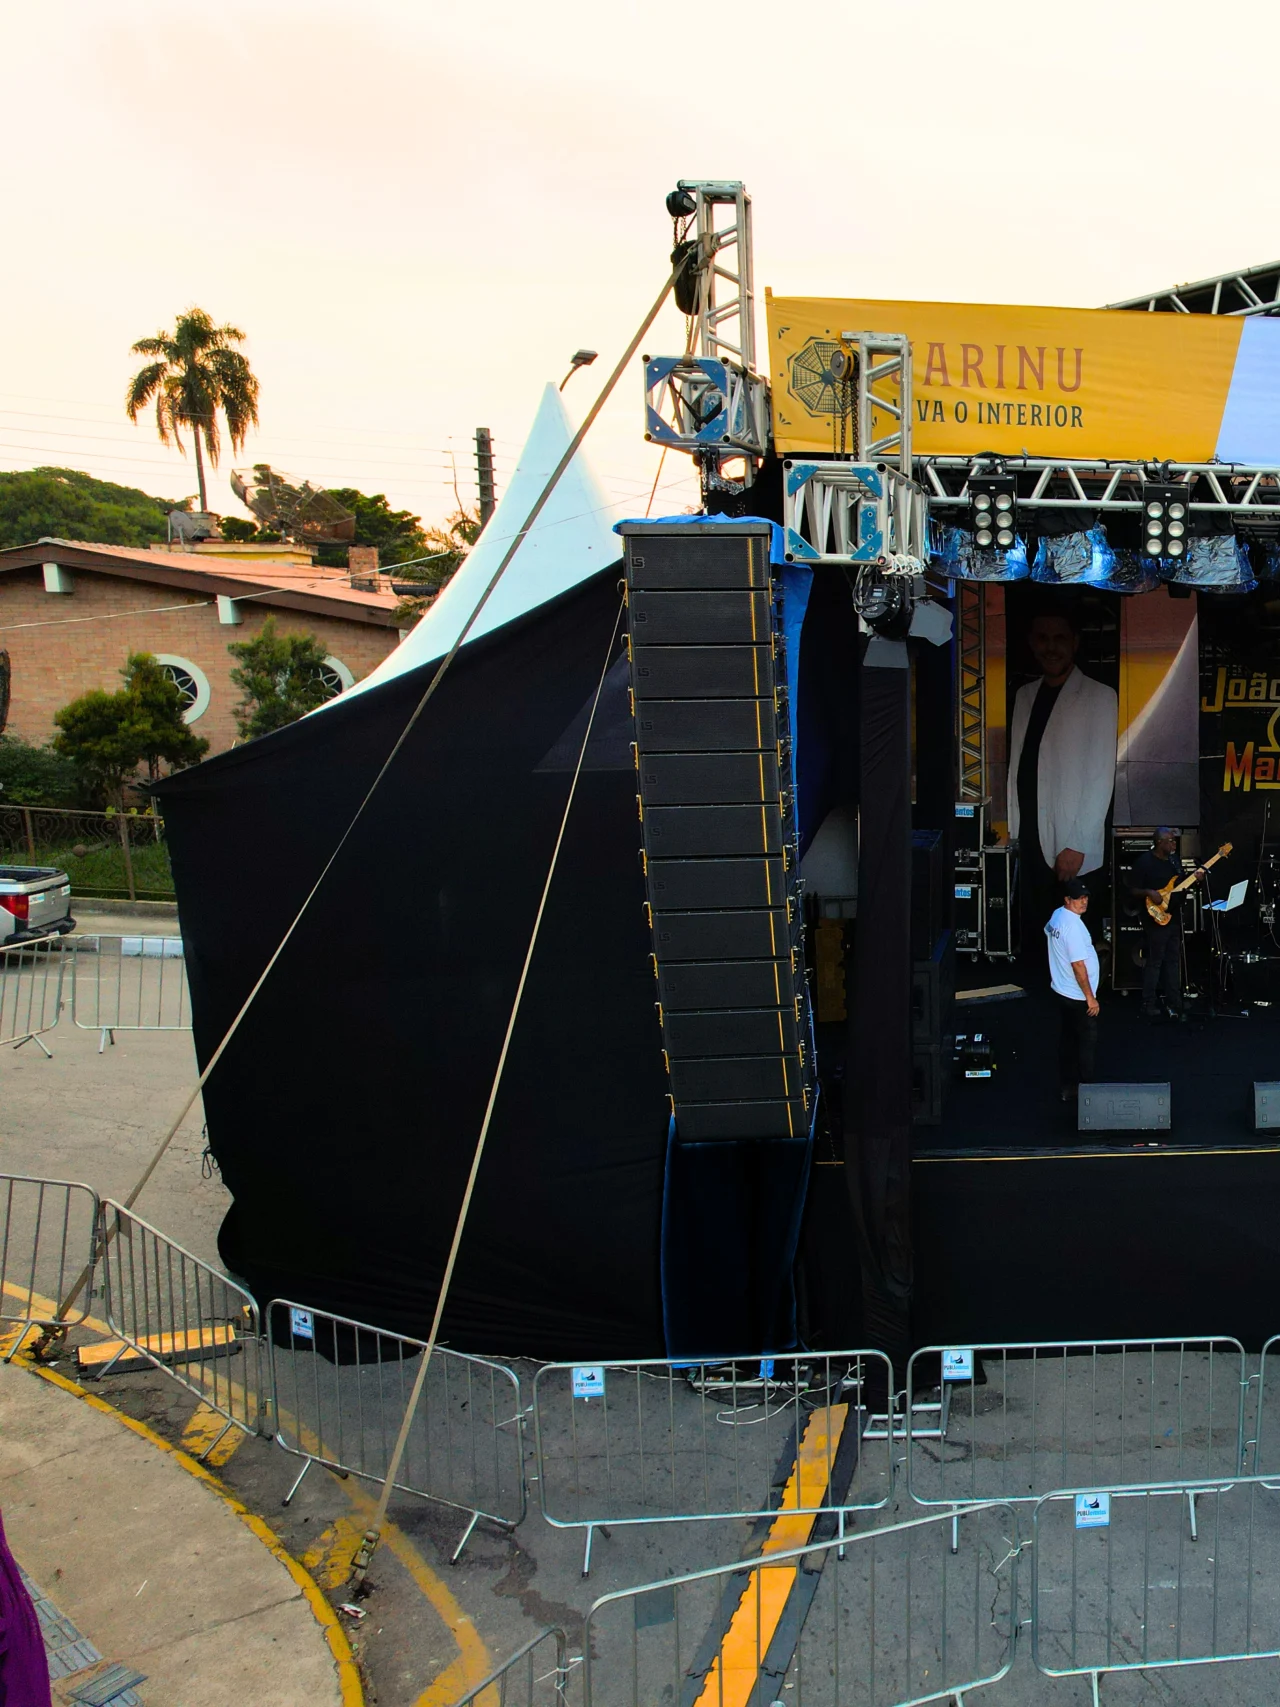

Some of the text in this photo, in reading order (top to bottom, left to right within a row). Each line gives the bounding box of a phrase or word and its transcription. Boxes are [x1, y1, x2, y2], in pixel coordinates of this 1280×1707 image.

[892, 398, 1084, 428] VA O INTERIOR
[632, 557, 644, 567] LS
